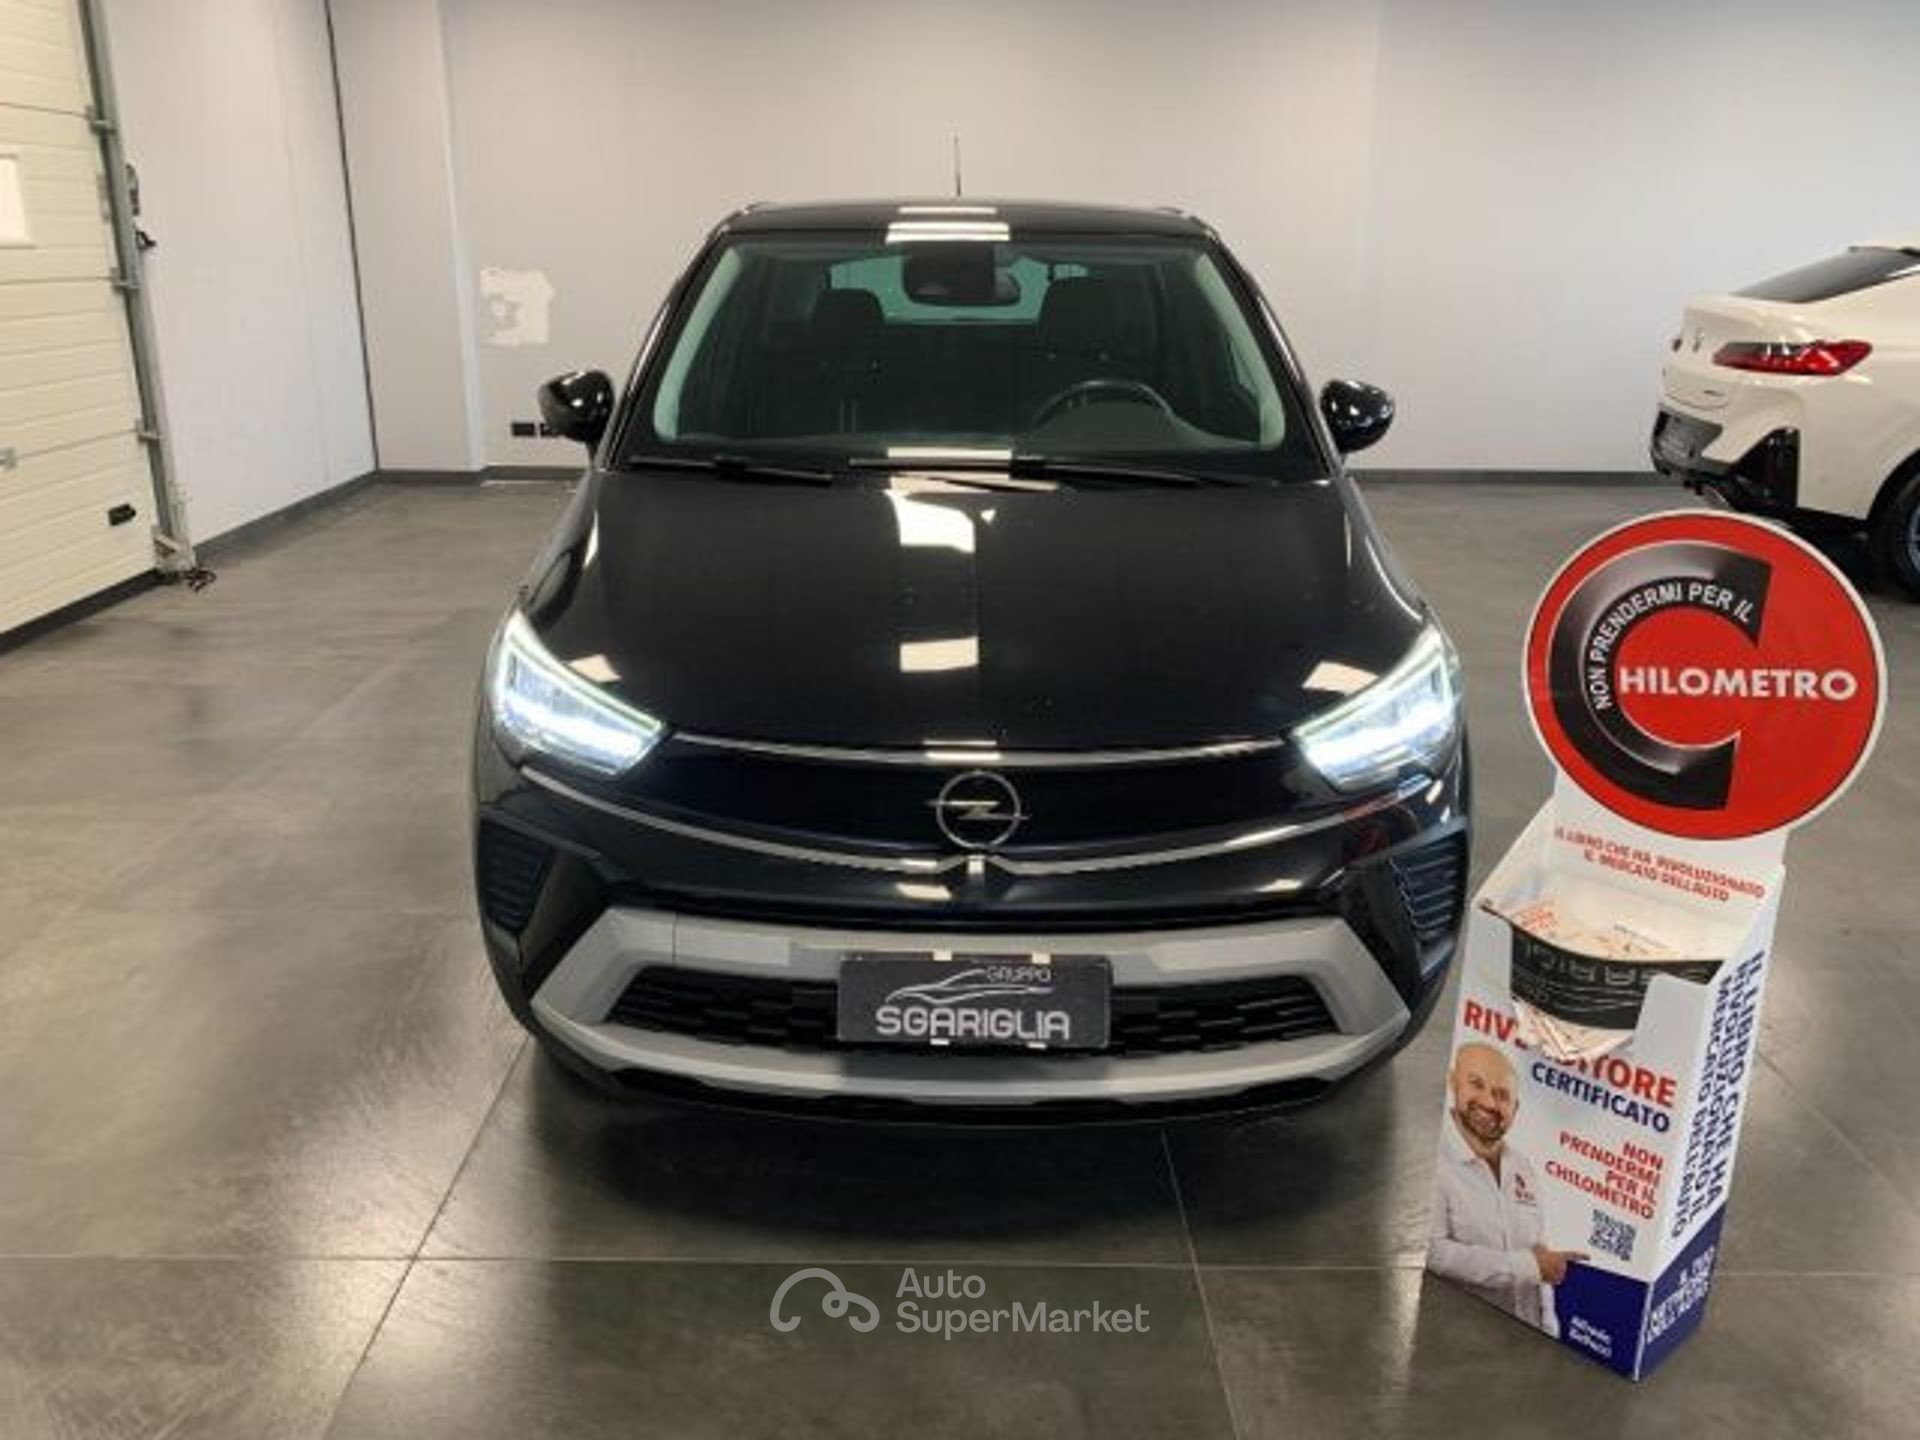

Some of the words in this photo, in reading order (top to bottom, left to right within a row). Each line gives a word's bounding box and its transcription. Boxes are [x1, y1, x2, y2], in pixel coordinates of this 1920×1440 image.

[1688, 583, 1734, 610] PER
[1733, 599, 1755, 623] IL
[1590, 583, 1682, 662] PRENDERMI
[1589, 667, 1612, 710] NON
[875, 1005, 1071, 1041] SGARIGLIA
[1532, 1062, 1671, 1133] CERTIFICATO
[1559, 1131, 1661, 1187] PRENDERMI
[1622, 1141, 1664, 1171] NON
[1545, 1160, 1654, 1220] CHILOMETRO
[1605, 1170, 1638, 1195] PER
